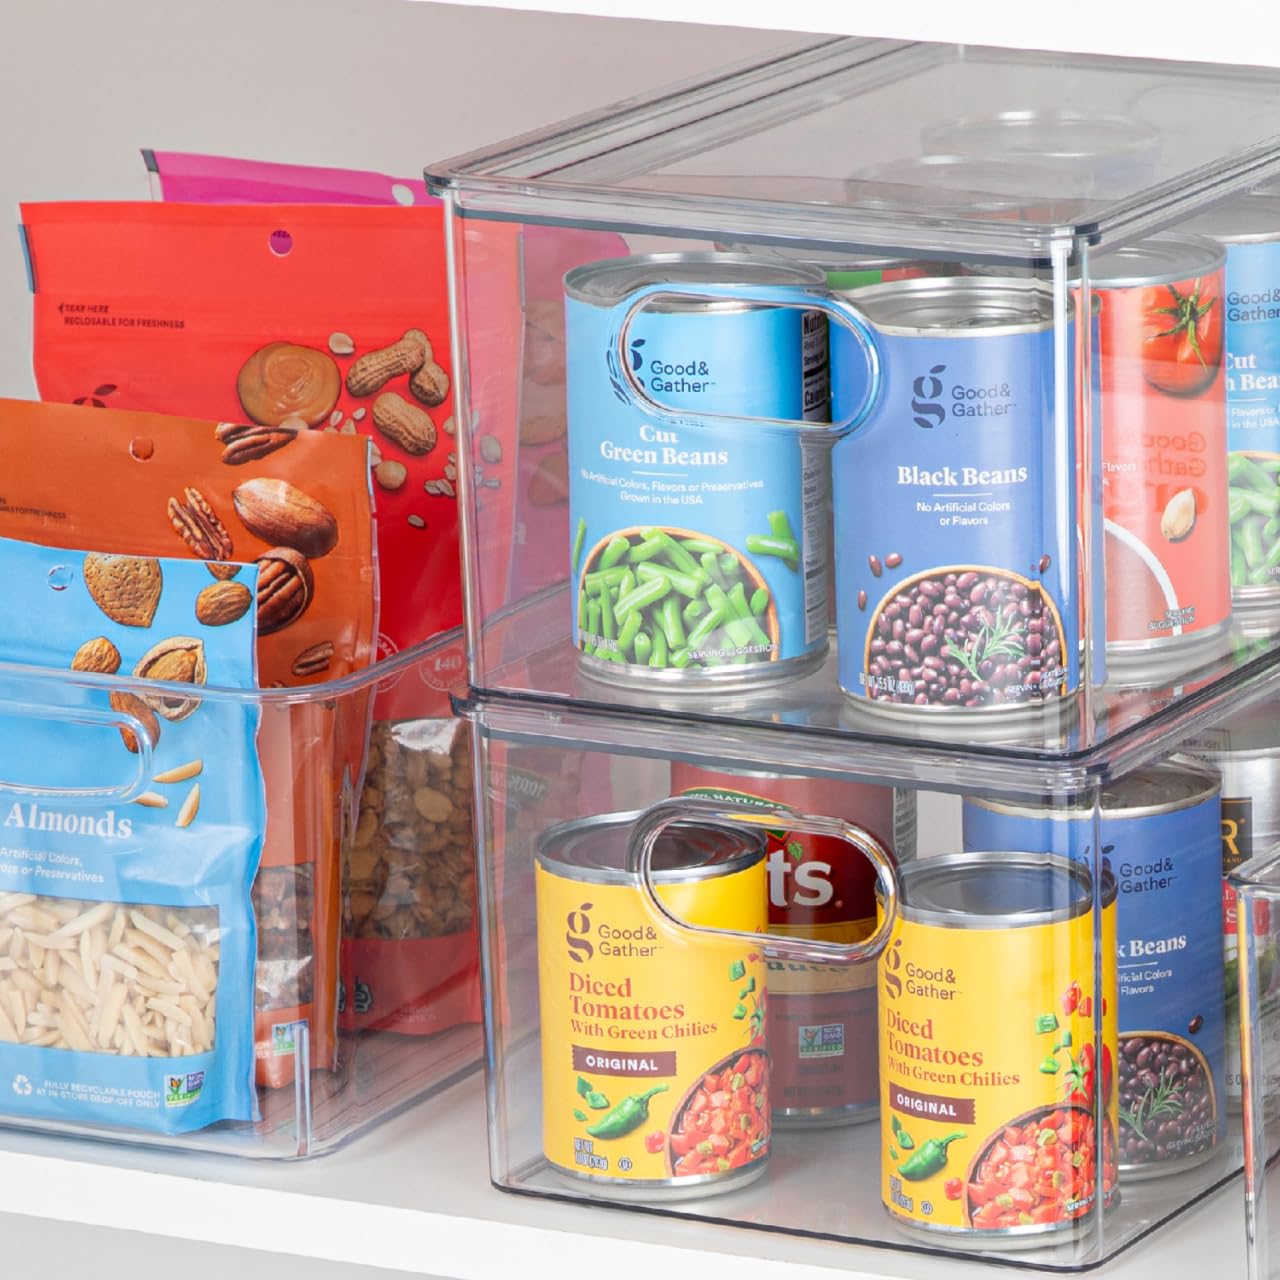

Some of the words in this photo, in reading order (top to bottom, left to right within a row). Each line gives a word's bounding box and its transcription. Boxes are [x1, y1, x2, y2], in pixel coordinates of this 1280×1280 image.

[64, 317, 116, 328] RECLOSABLE
[119, 318, 135, 327] FOR
[137, 318, 185, 329] FRESHNESS
[1228, 307, 1280, 322] Gather
[651, 377, 709, 392] Gather
[952, 402, 1010, 417] Gather
[1259, 416, 1280, 427] USA
[640, 425, 679, 443] Cut
[601, 440, 656, 464] Green
[662, 447, 728, 465] Beans
[897, 465, 956, 486] Black
[963, 465, 1027, 485] Beans
[620, 491, 650, 503] Grown
[652, 494, 660, 503] in
[663, 494, 678, 504] the
[681, 495, 703, 504] USA
[917, 502, 931, 512] No
[933, 501, 976, 513] Artificial
[978, 501, 1010, 511] Colors
[940, 517, 950, 526] or
[952, 516, 988, 526] Flavors
[688, 648, 727, 660] SERVING
[4, 803, 134, 840] Almonds
[1120, 876, 1172, 894] Gather
[599, 942, 656, 958] Gather
[1130, 935, 1186, 957] Beans
[1144, 968, 1172, 981] Colors
[569, 972, 632, 999] Diced
[906, 980, 956, 1000] Gather
[1120, 984, 1154, 996] Flavors
[569, 995, 685, 1021] Tomatoes
[571, 1020, 606, 1038] With
[608, 1025, 657, 1040] Green
[662, 1021, 718, 1040] Chilies
[887, 1008, 933, 1040] Diced
[887, 1031, 983, 1067] Tomatoes
[586, 1055, 658, 1072] ORIGINAL
[888, 1057, 910, 1078] With
[913, 1064, 956, 1085] Green
[960, 1071, 1020, 1087] Chilies
[896, 1094, 957, 1117] ORIGINAL
